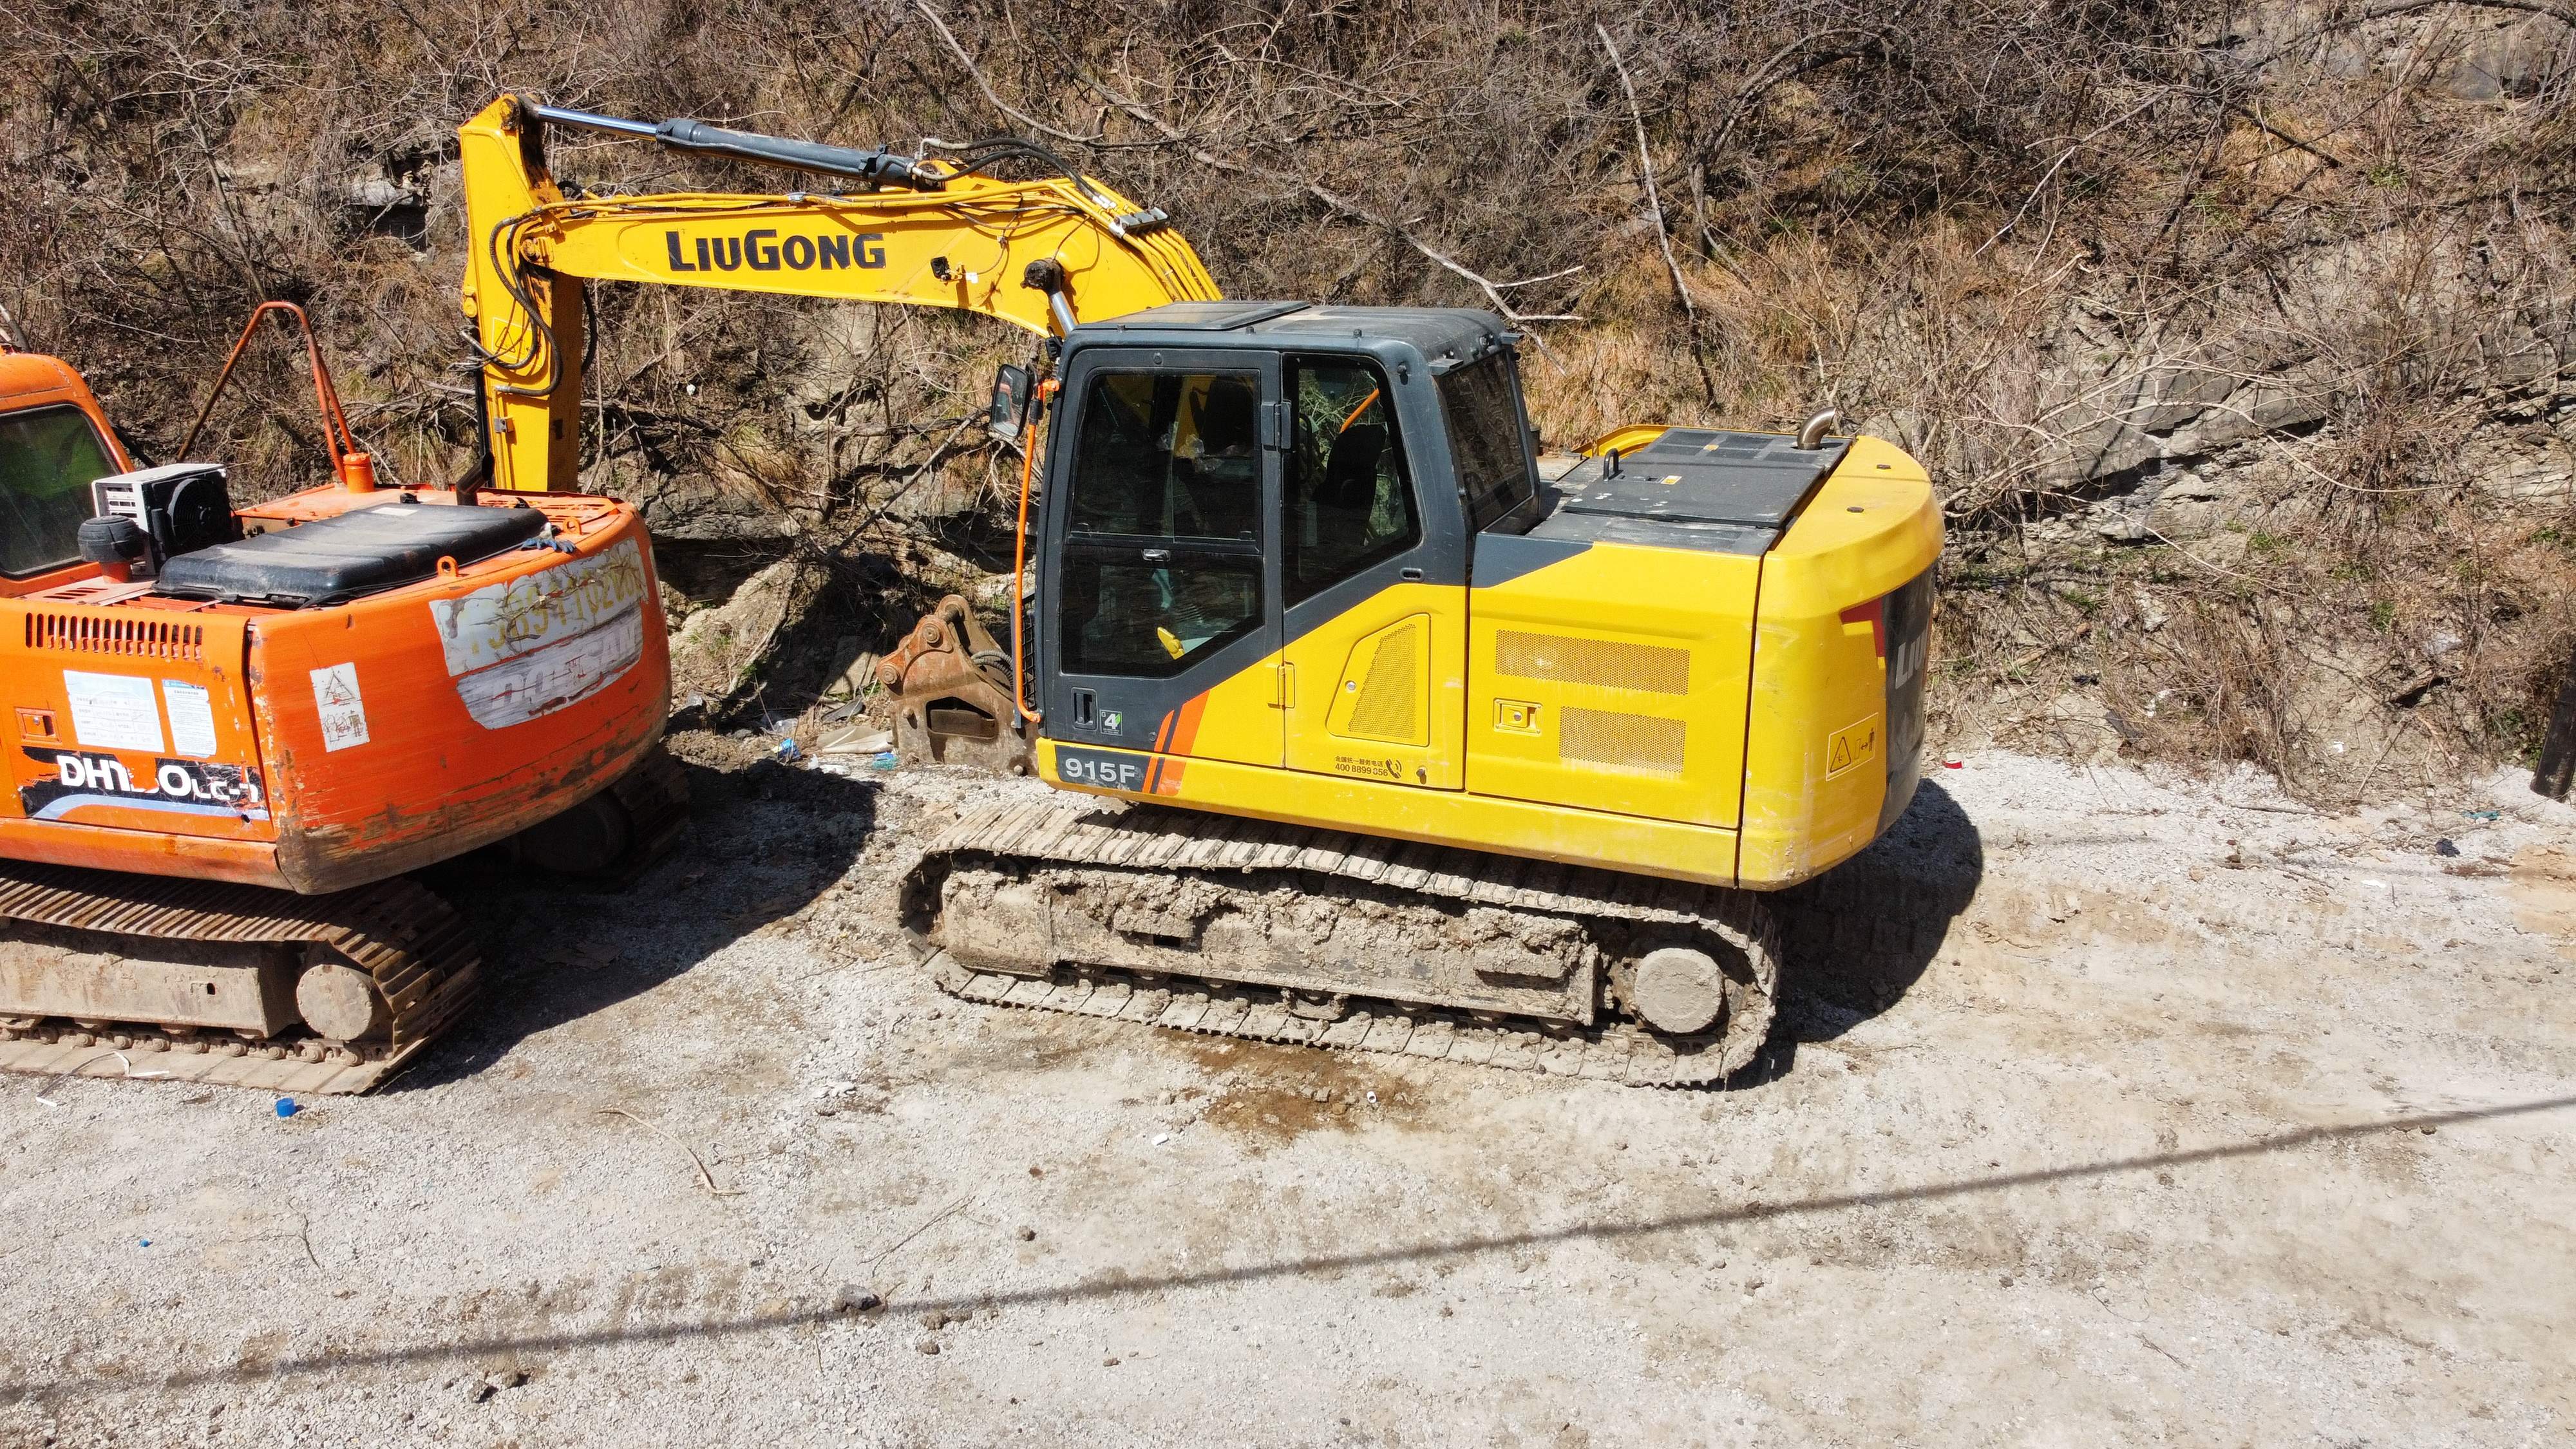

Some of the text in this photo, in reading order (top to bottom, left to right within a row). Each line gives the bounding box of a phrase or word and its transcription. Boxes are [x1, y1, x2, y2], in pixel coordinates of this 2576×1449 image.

[1335, 755, 1383, 768] 全国统一服务电话
[1065, 758, 1135, 783] 915F
[1335, 763, 1350, 772] 400
[1352, 765, 1372, 774] 8899
